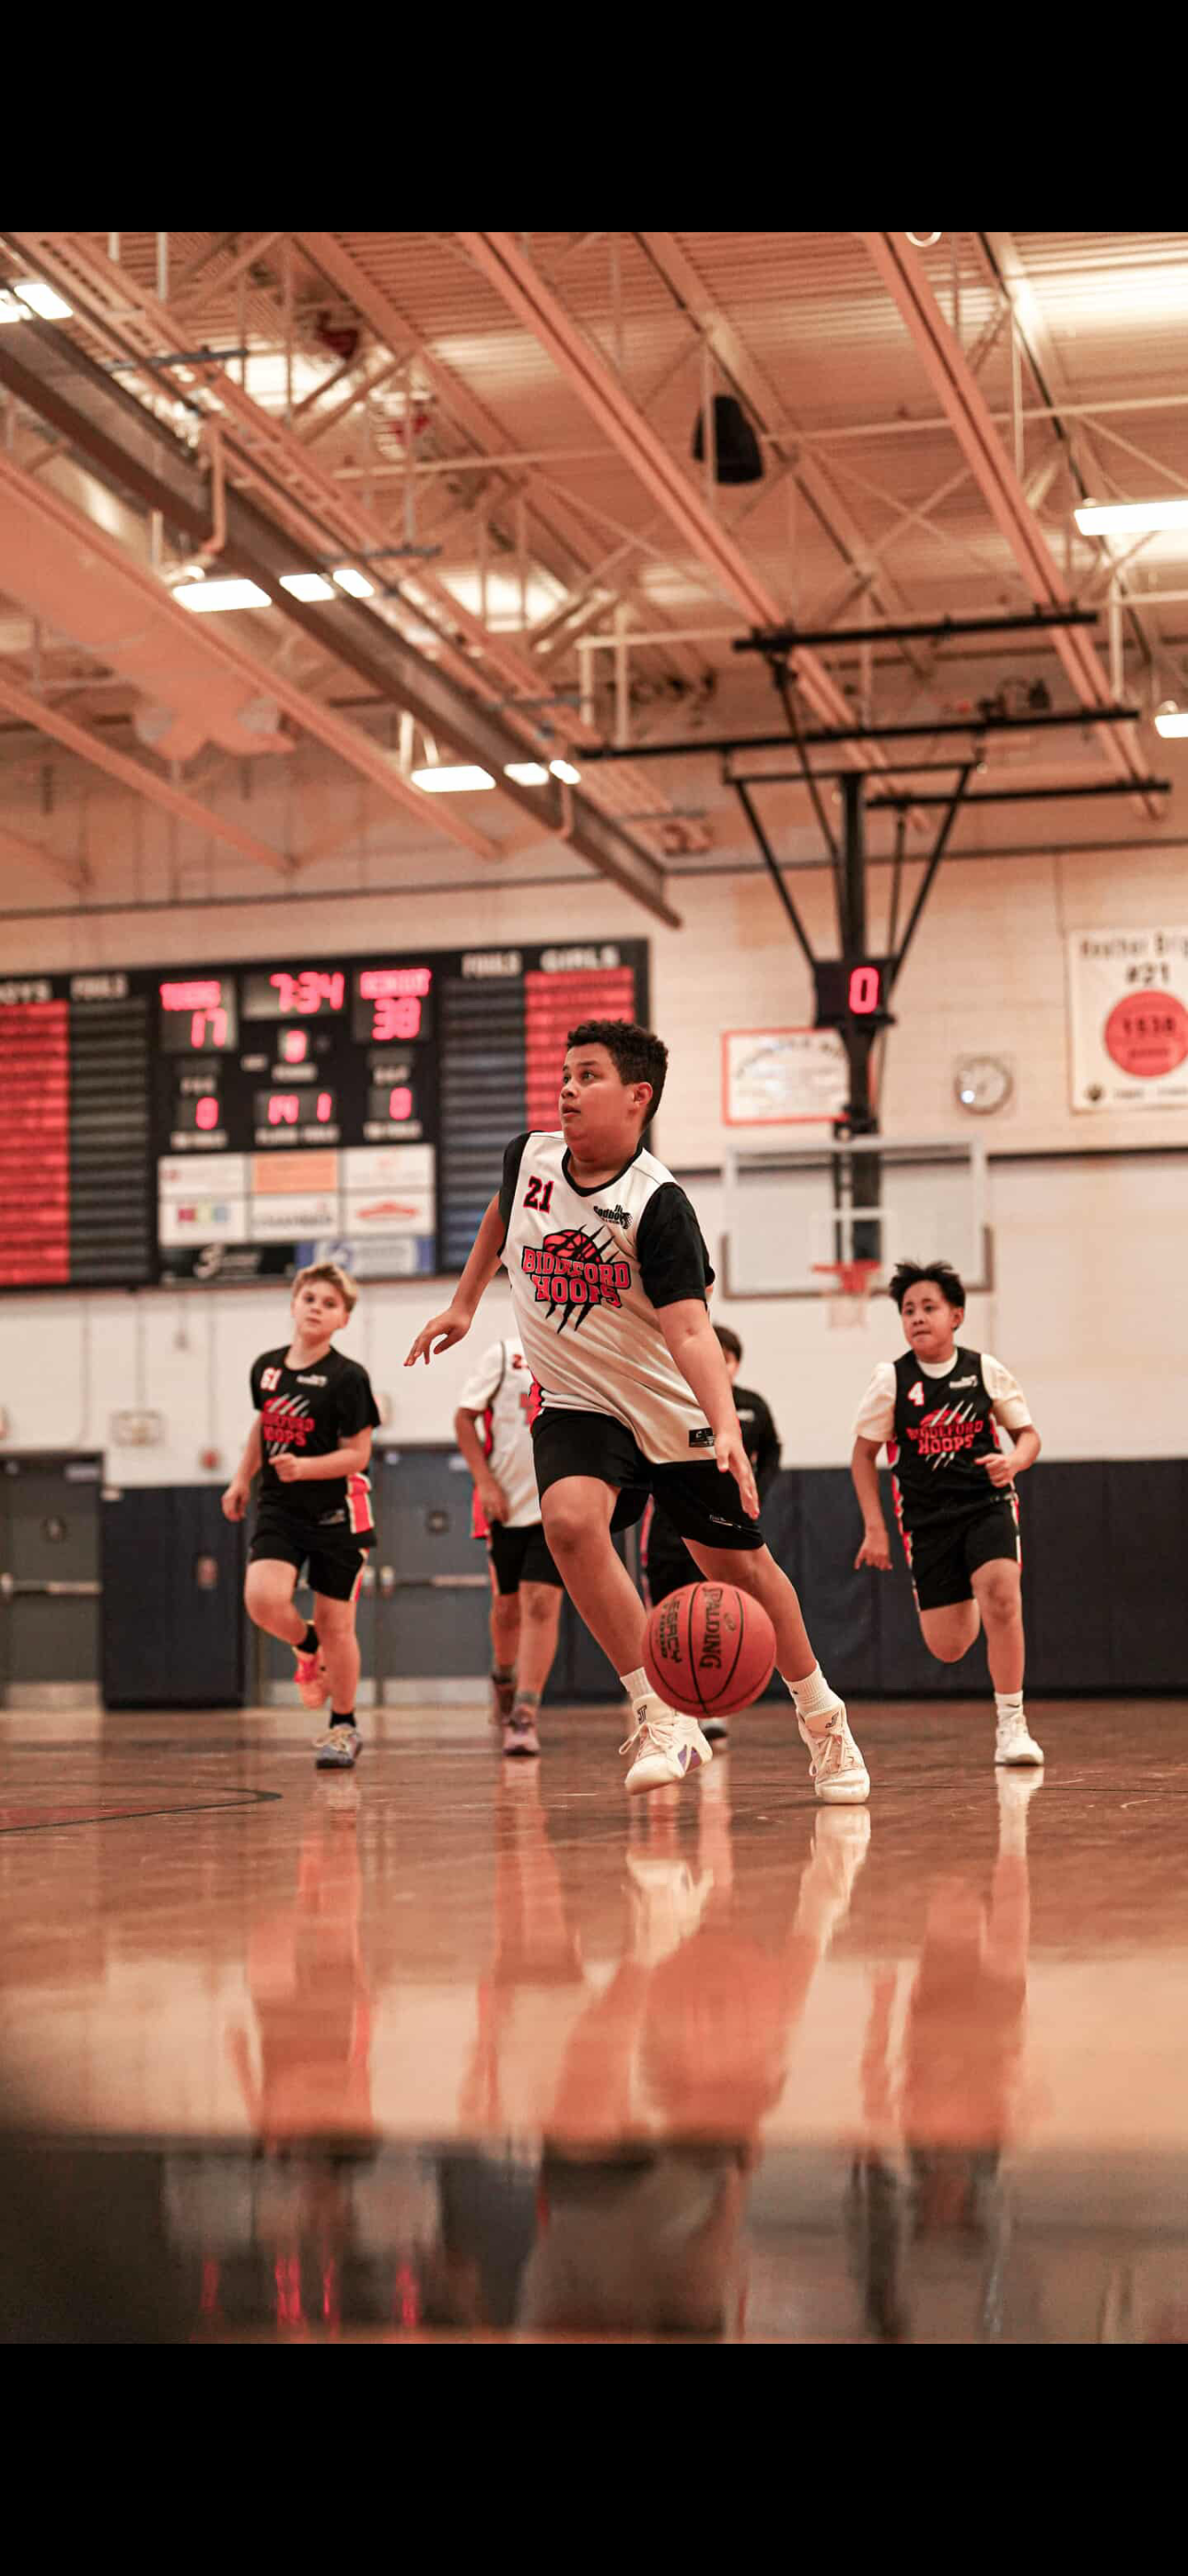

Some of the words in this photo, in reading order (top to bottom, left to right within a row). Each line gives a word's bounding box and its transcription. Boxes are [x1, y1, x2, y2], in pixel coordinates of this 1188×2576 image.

[540, 946, 620, 973] GIRLS
[270, 971, 344, 1014] 7:34
[849, 966, 879, 1014] 0
[191, 1007, 227, 1048] 17
[523, 1175, 554, 1213] 21
[521, 1247, 631, 1289] BIDDEFORD
[530, 1274, 622, 1308] HOOPS
[907, 1381, 925, 1406] 4
[917, 1434, 976, 1456] HOOPS
[699, 1586, 724, 1669] SPALDING
